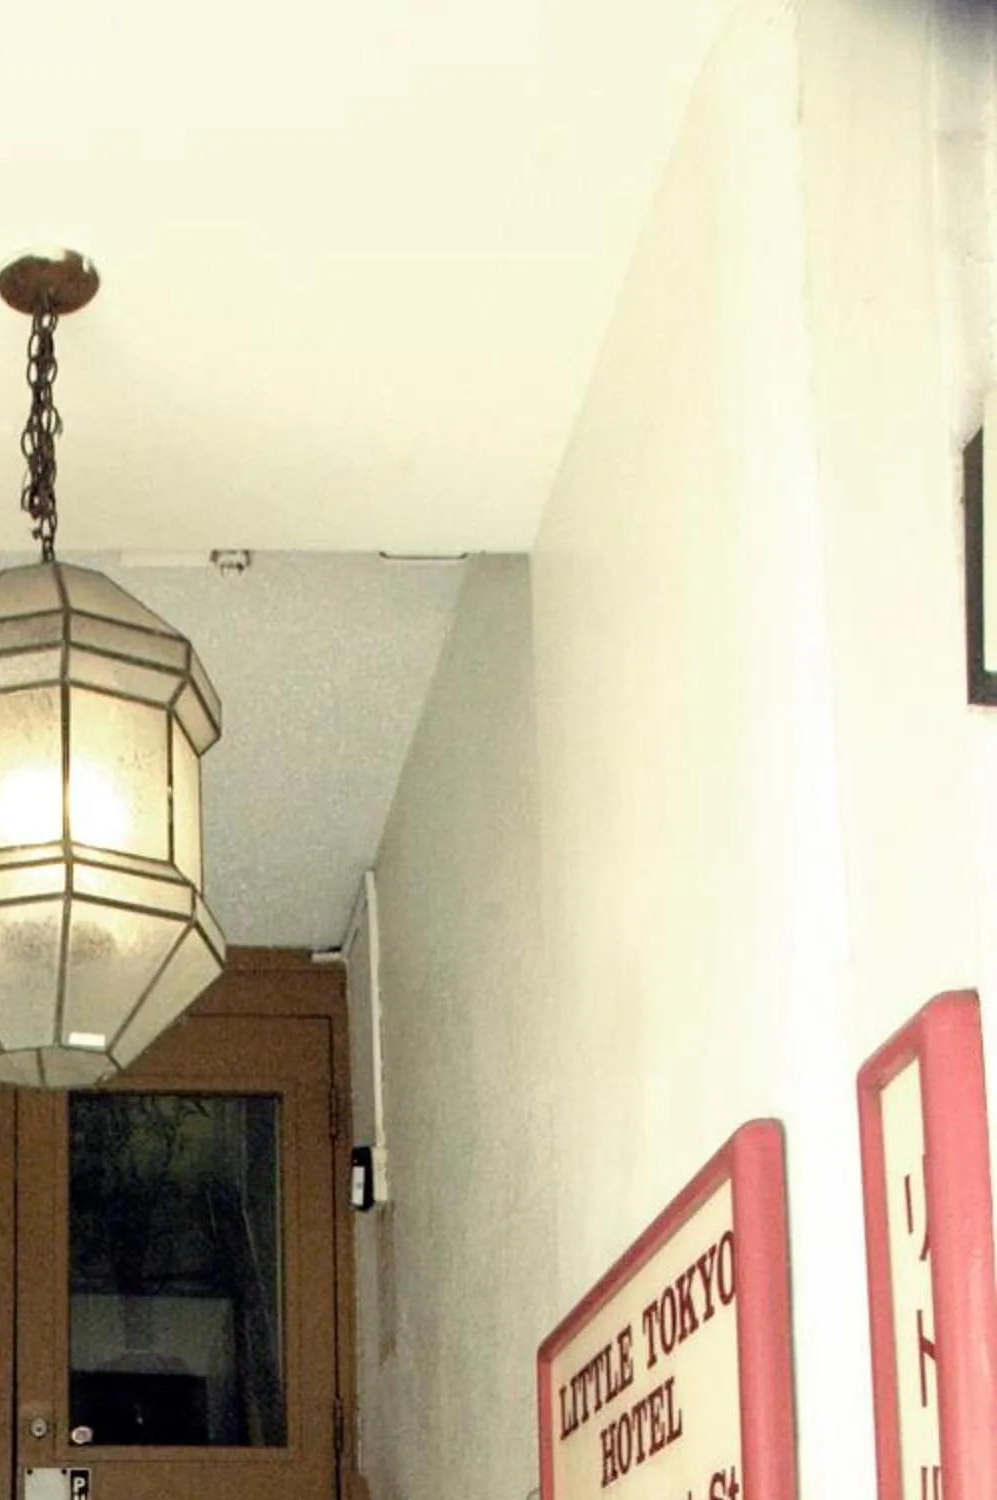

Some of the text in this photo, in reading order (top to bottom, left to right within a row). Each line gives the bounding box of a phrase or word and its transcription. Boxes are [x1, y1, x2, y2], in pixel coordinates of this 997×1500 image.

[558, 1229, 736, 1442] LITTLE TOKYO
[600, 1375, 684, 1489] HOTEL
